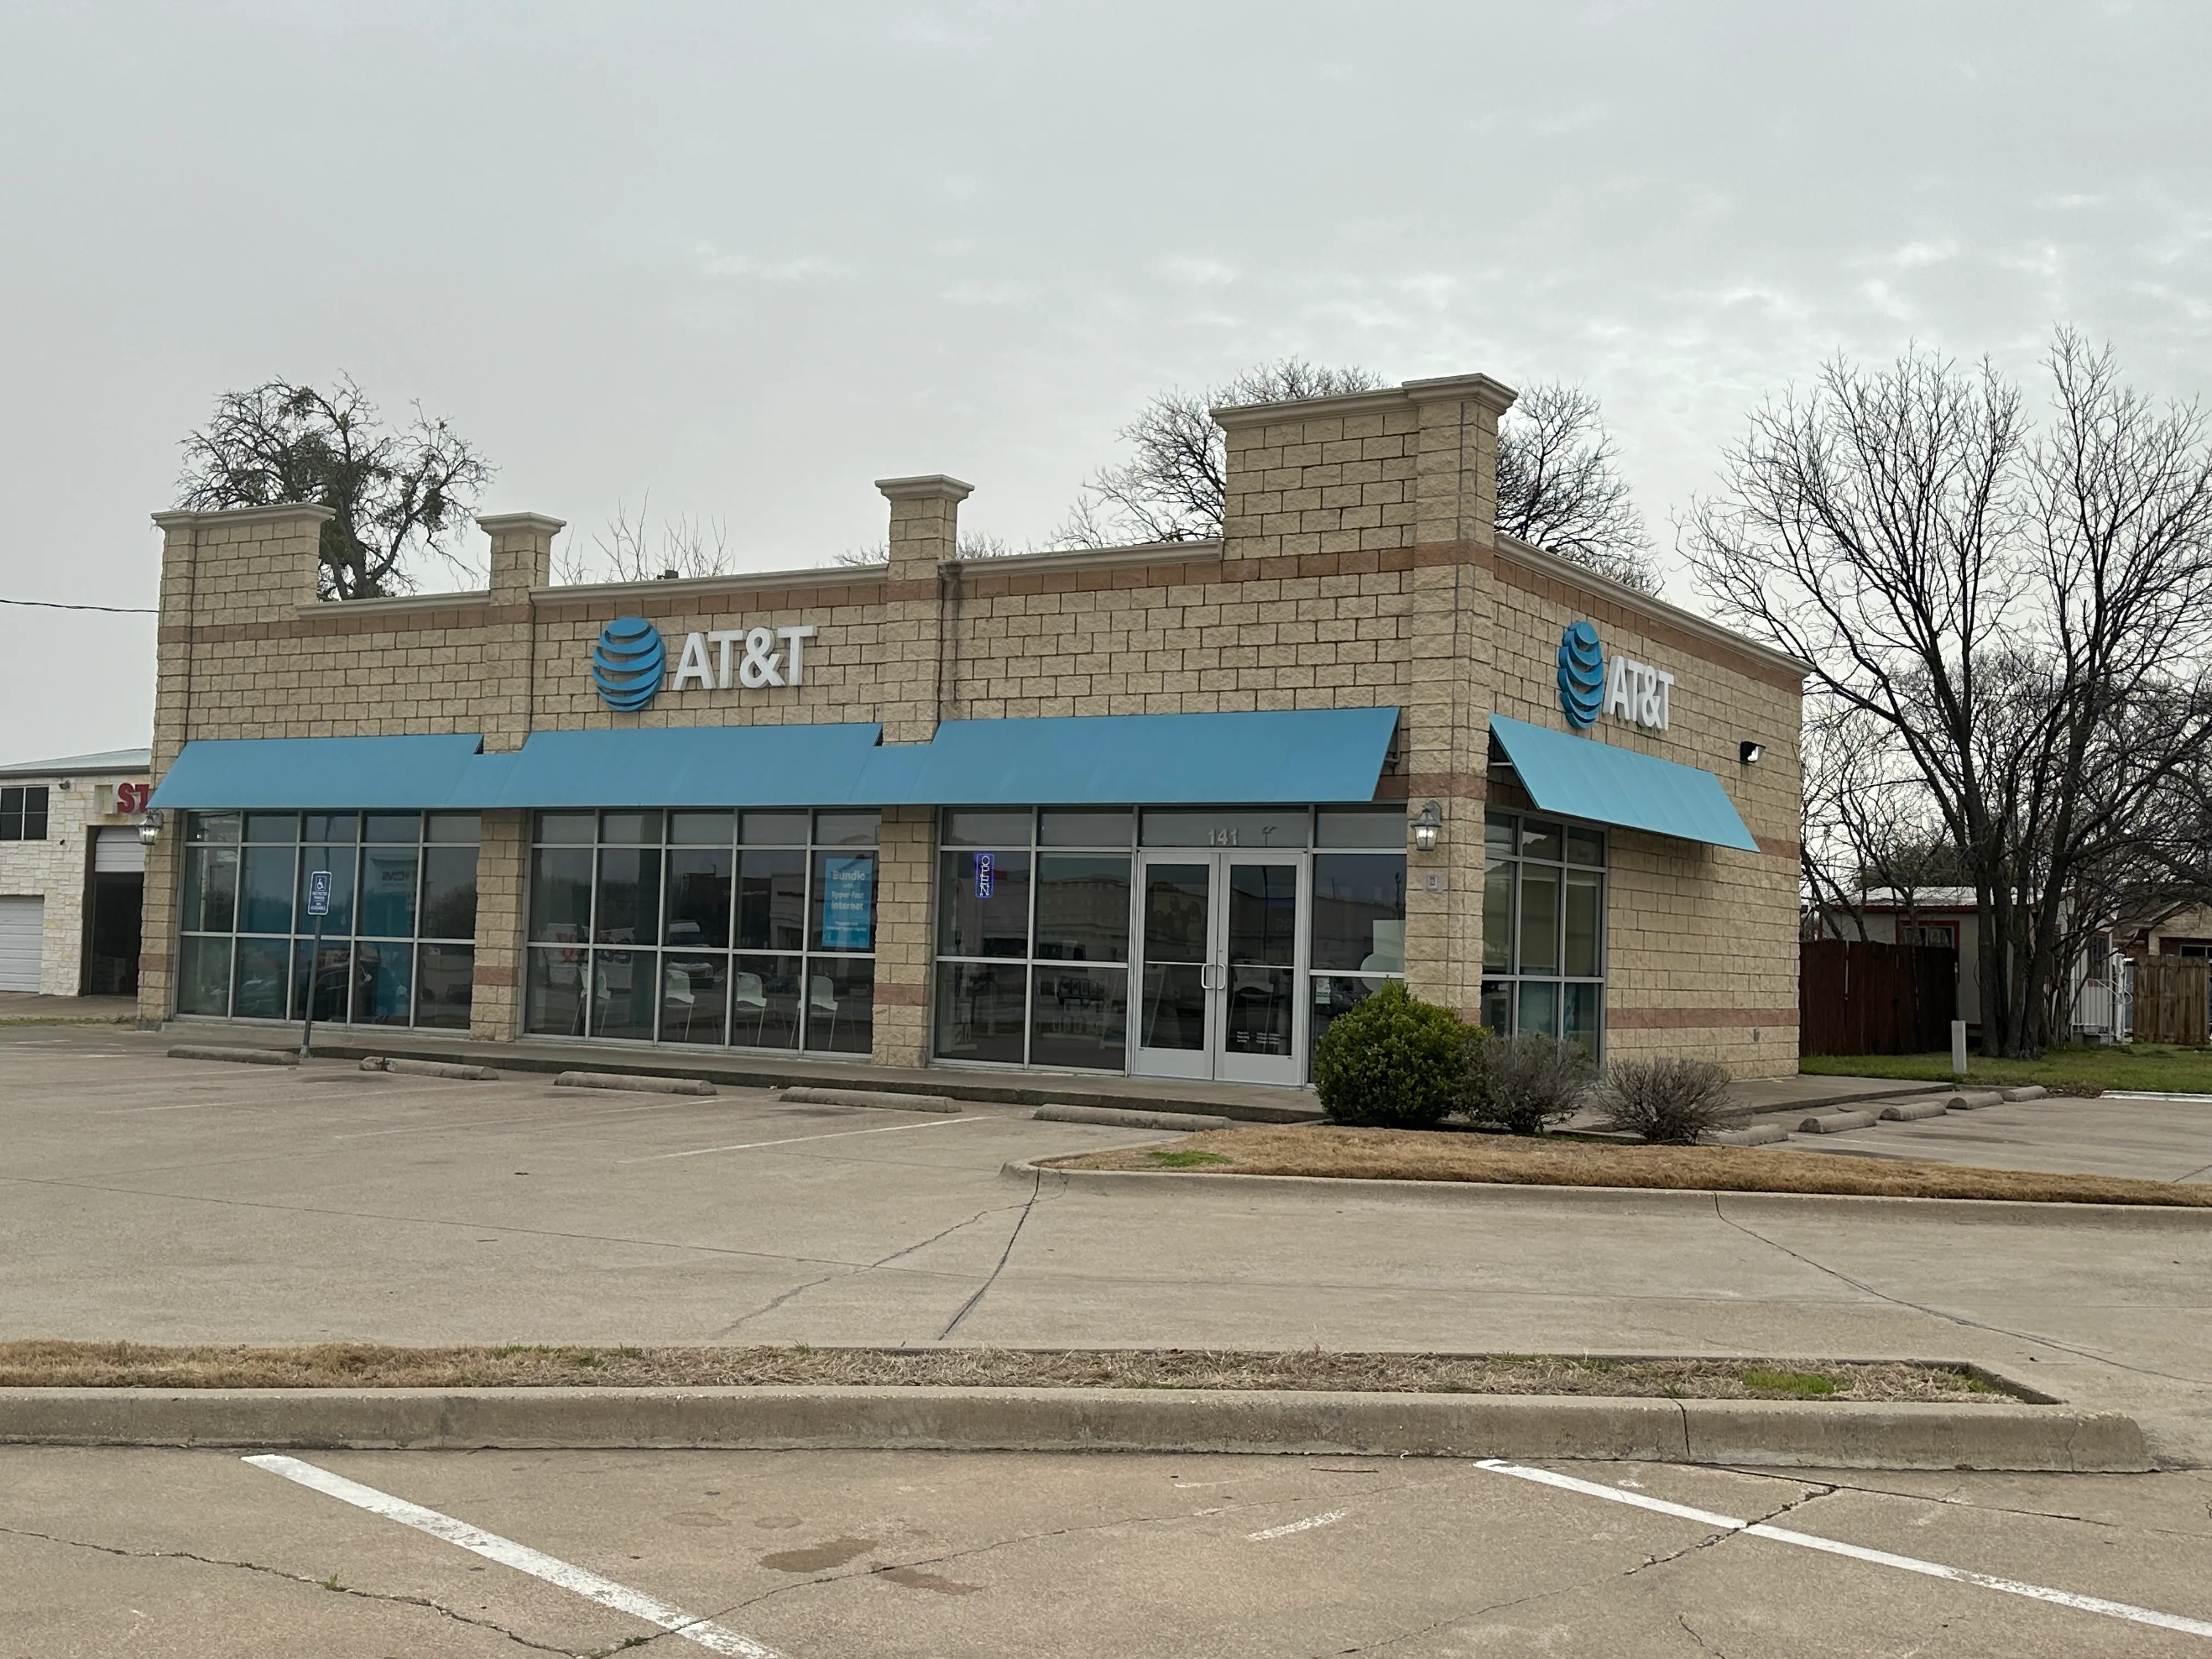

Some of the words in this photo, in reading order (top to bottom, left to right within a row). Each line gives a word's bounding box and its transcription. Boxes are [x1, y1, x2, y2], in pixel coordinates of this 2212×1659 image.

[672, 625, 818, 691] AT&T
[1602, 655, 1675, 731] AT&T
[1208, 828, 1238, 845] 141
[831, 870, 866, 881] Bundle
[979, 855, 990, 896] OPEN
[831, 890, 865, 900] hyper-fast
[831, 900, 865, 911] internet
